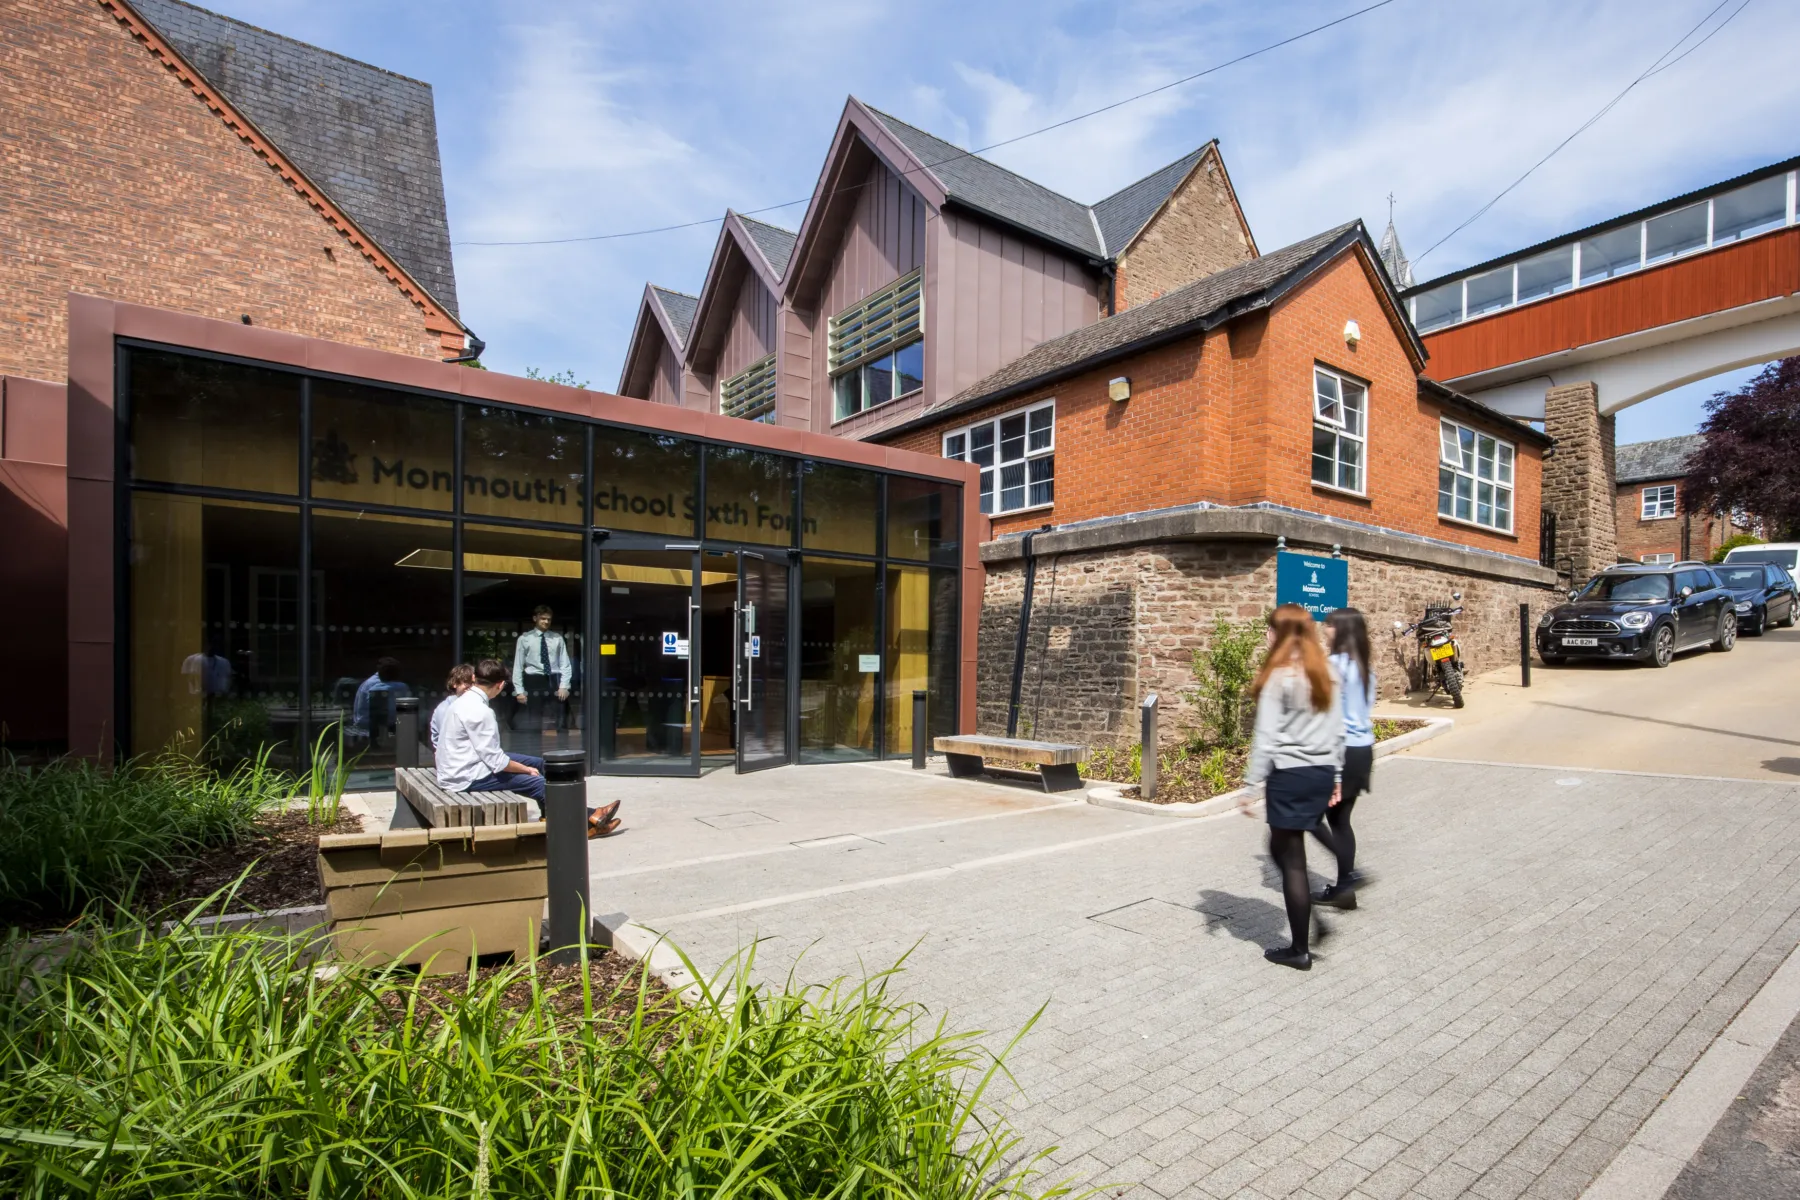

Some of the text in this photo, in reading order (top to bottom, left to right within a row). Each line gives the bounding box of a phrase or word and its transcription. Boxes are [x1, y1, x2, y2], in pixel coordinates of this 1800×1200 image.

[372, 456, 567, 506] Monmouth
[683, 494, 749, 527] Sxth
[757, 504, 817, 535] Form
[1304, 602, 1319, 612] Form
